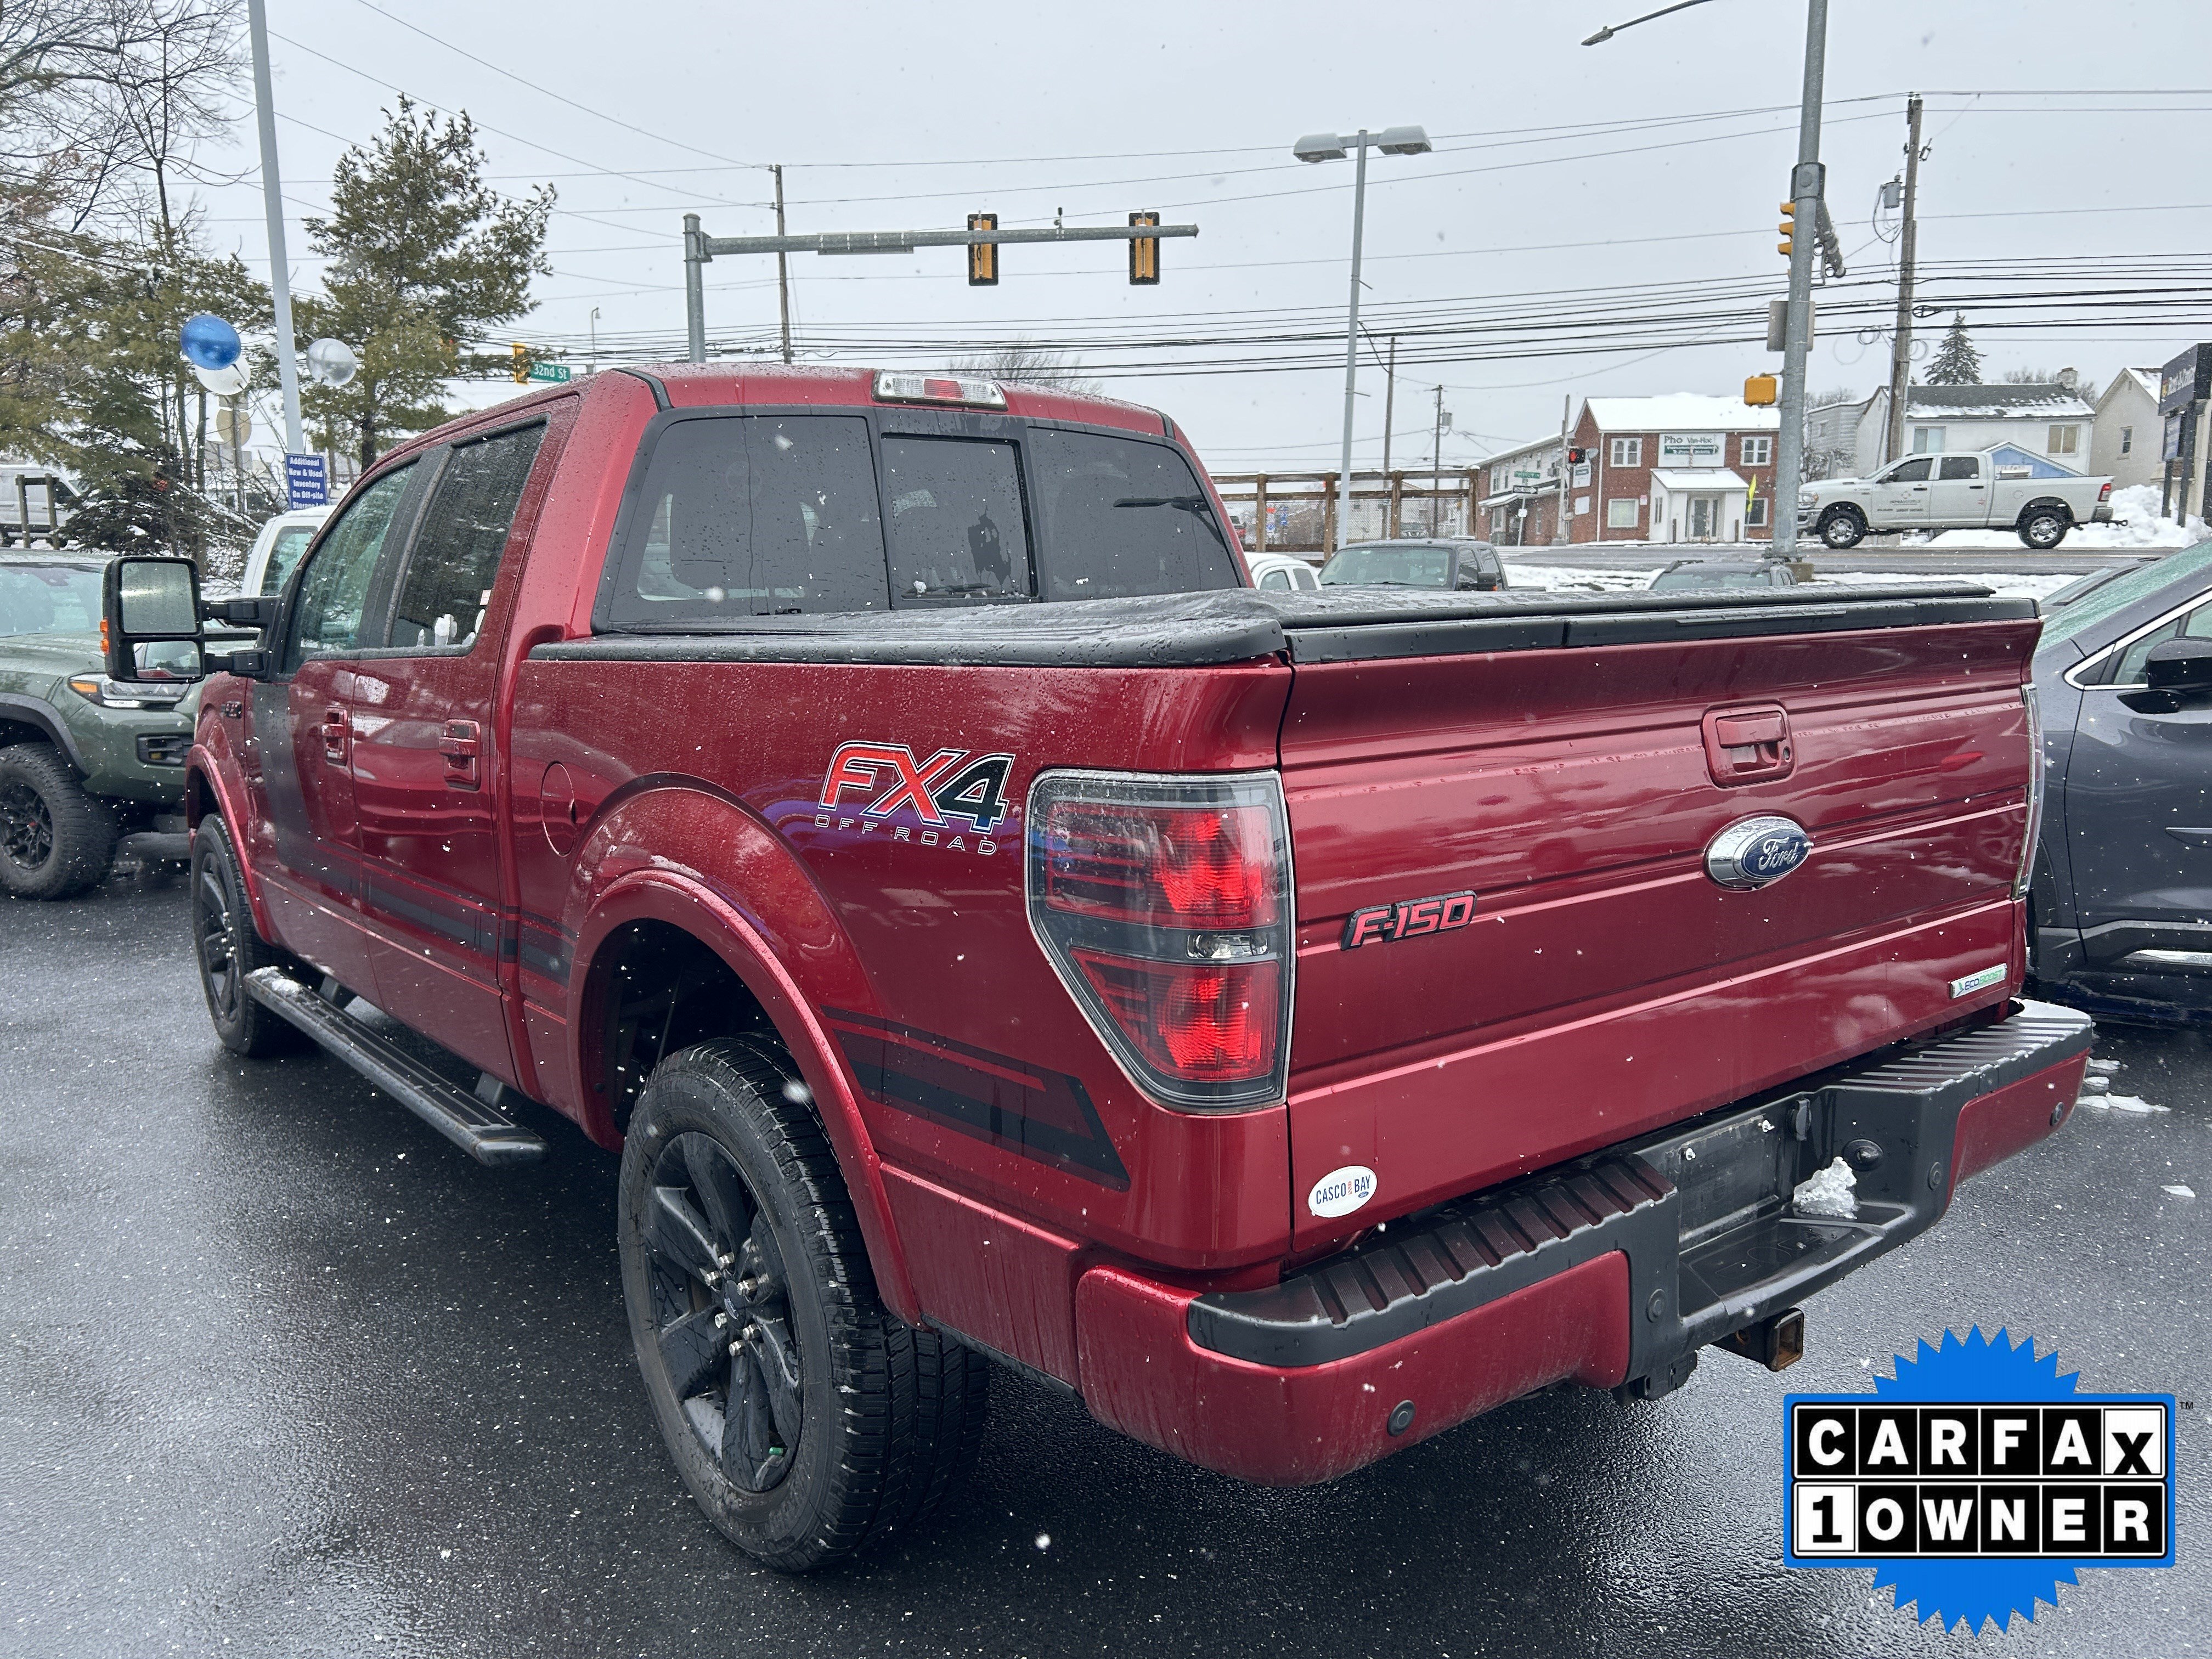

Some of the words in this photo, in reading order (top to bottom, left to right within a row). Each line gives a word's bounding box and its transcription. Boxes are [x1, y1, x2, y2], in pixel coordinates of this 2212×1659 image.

[534, 364, 555, 377] 32nd
[557, 368, 567, 380] St
[1664, 436, 1683, 444] Pho
[290, 456, 320, 466] Additional
[289, 468, 301, 476] New
[308, 469, 323, 478] Used
[294, 479, 320, 489] Inventory
[292, 490, 301, 498] On
[817, 740, 1016, 835] FX4
[815, 814, 878, 834] OFF
[894, 827, 997, 856] ROAD
[1758, 837, 1799, 871] Ford
[1342, 890, 1477, 950] F-150
[1316, 1183, 1346, 1205] CASCO
[1355, 1175, 1370, 1193] BAY
